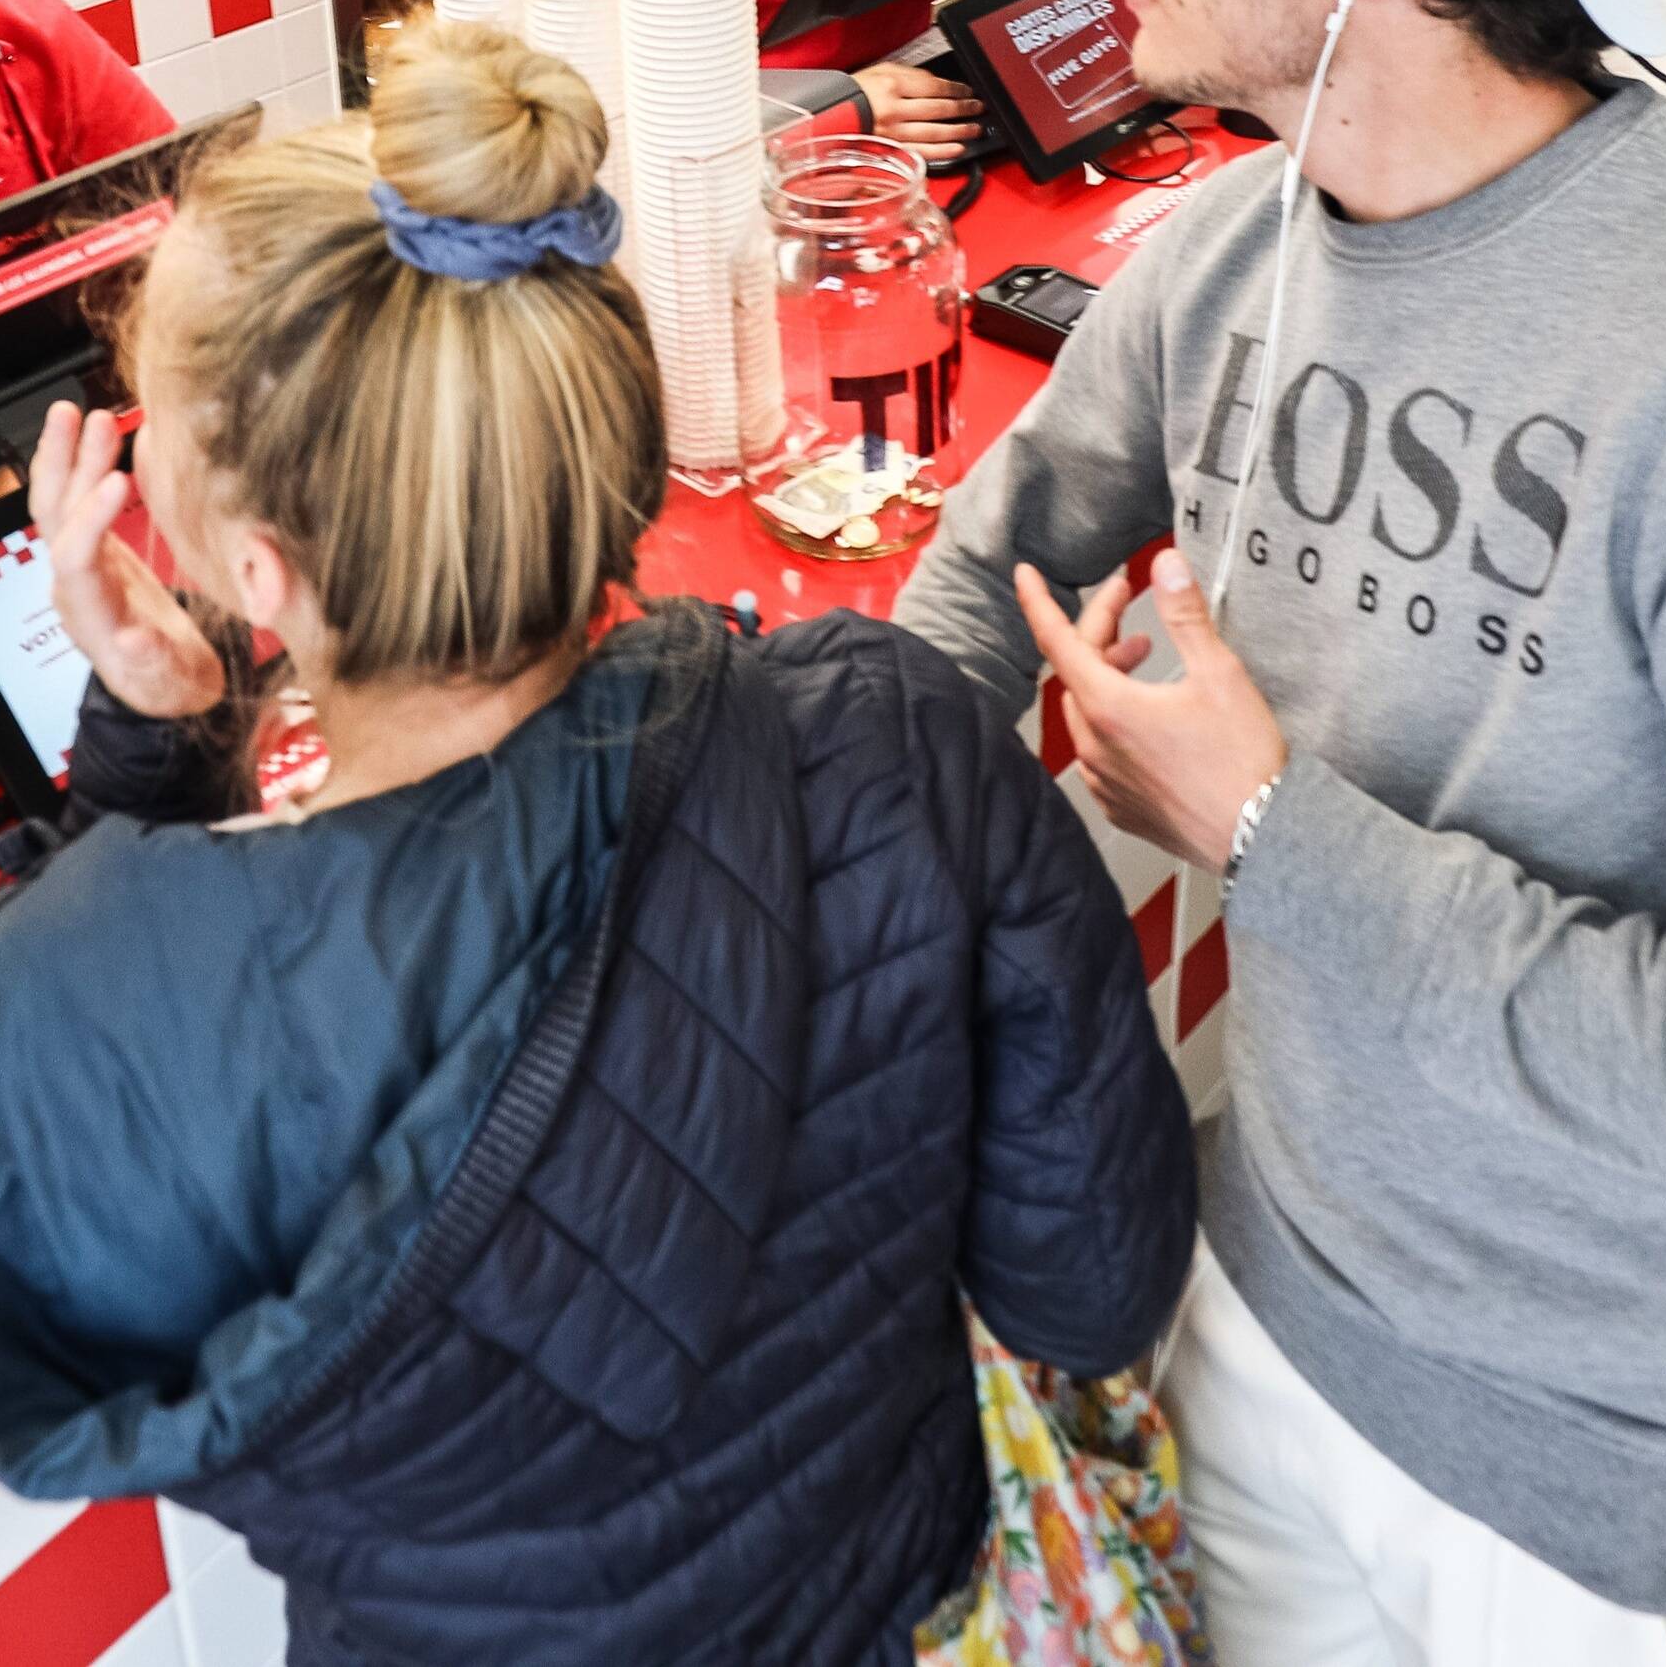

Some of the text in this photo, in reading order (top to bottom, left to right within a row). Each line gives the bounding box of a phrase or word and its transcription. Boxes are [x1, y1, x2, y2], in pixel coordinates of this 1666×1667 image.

[1046, 35, 1119, 87] FIVE GUYS
[1355, 573, 1547, 677] BOSS
